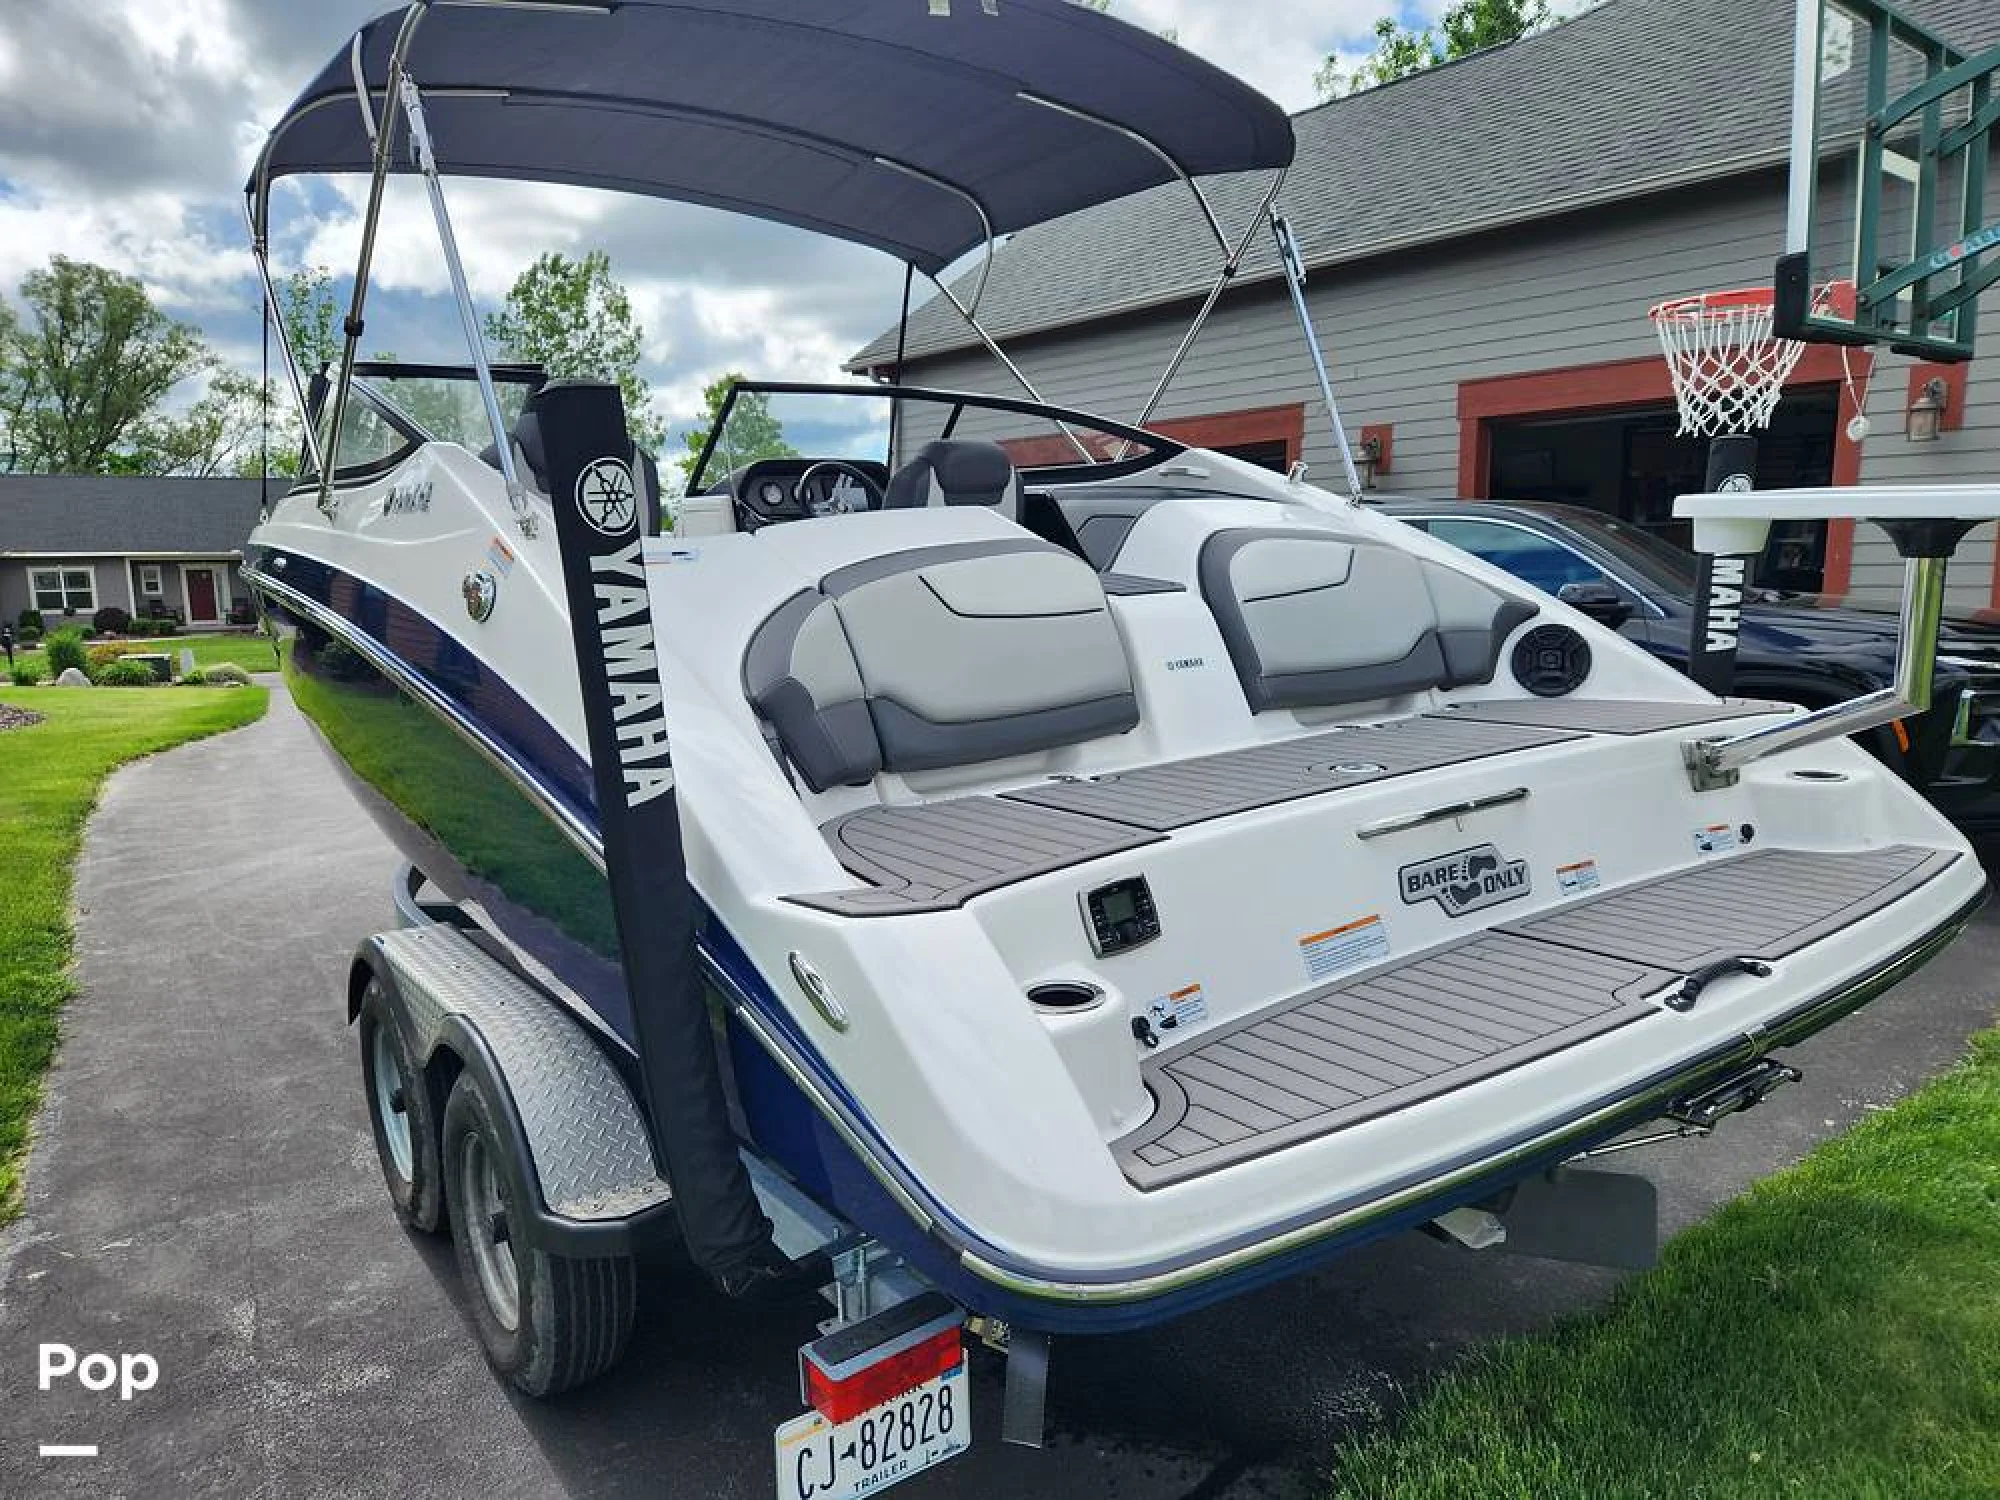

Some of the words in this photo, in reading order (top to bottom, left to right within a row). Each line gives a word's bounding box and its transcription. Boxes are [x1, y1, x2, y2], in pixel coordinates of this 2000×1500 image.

[1705, 553, 1745, 653] MAHA
[590, 539, 675, 808] YAMAHA
[1407, 863, 1459, 893] BARE
[1484, 865, 1526, 894] ONLY
[854, 1459, 908, 1492] TRAILER
